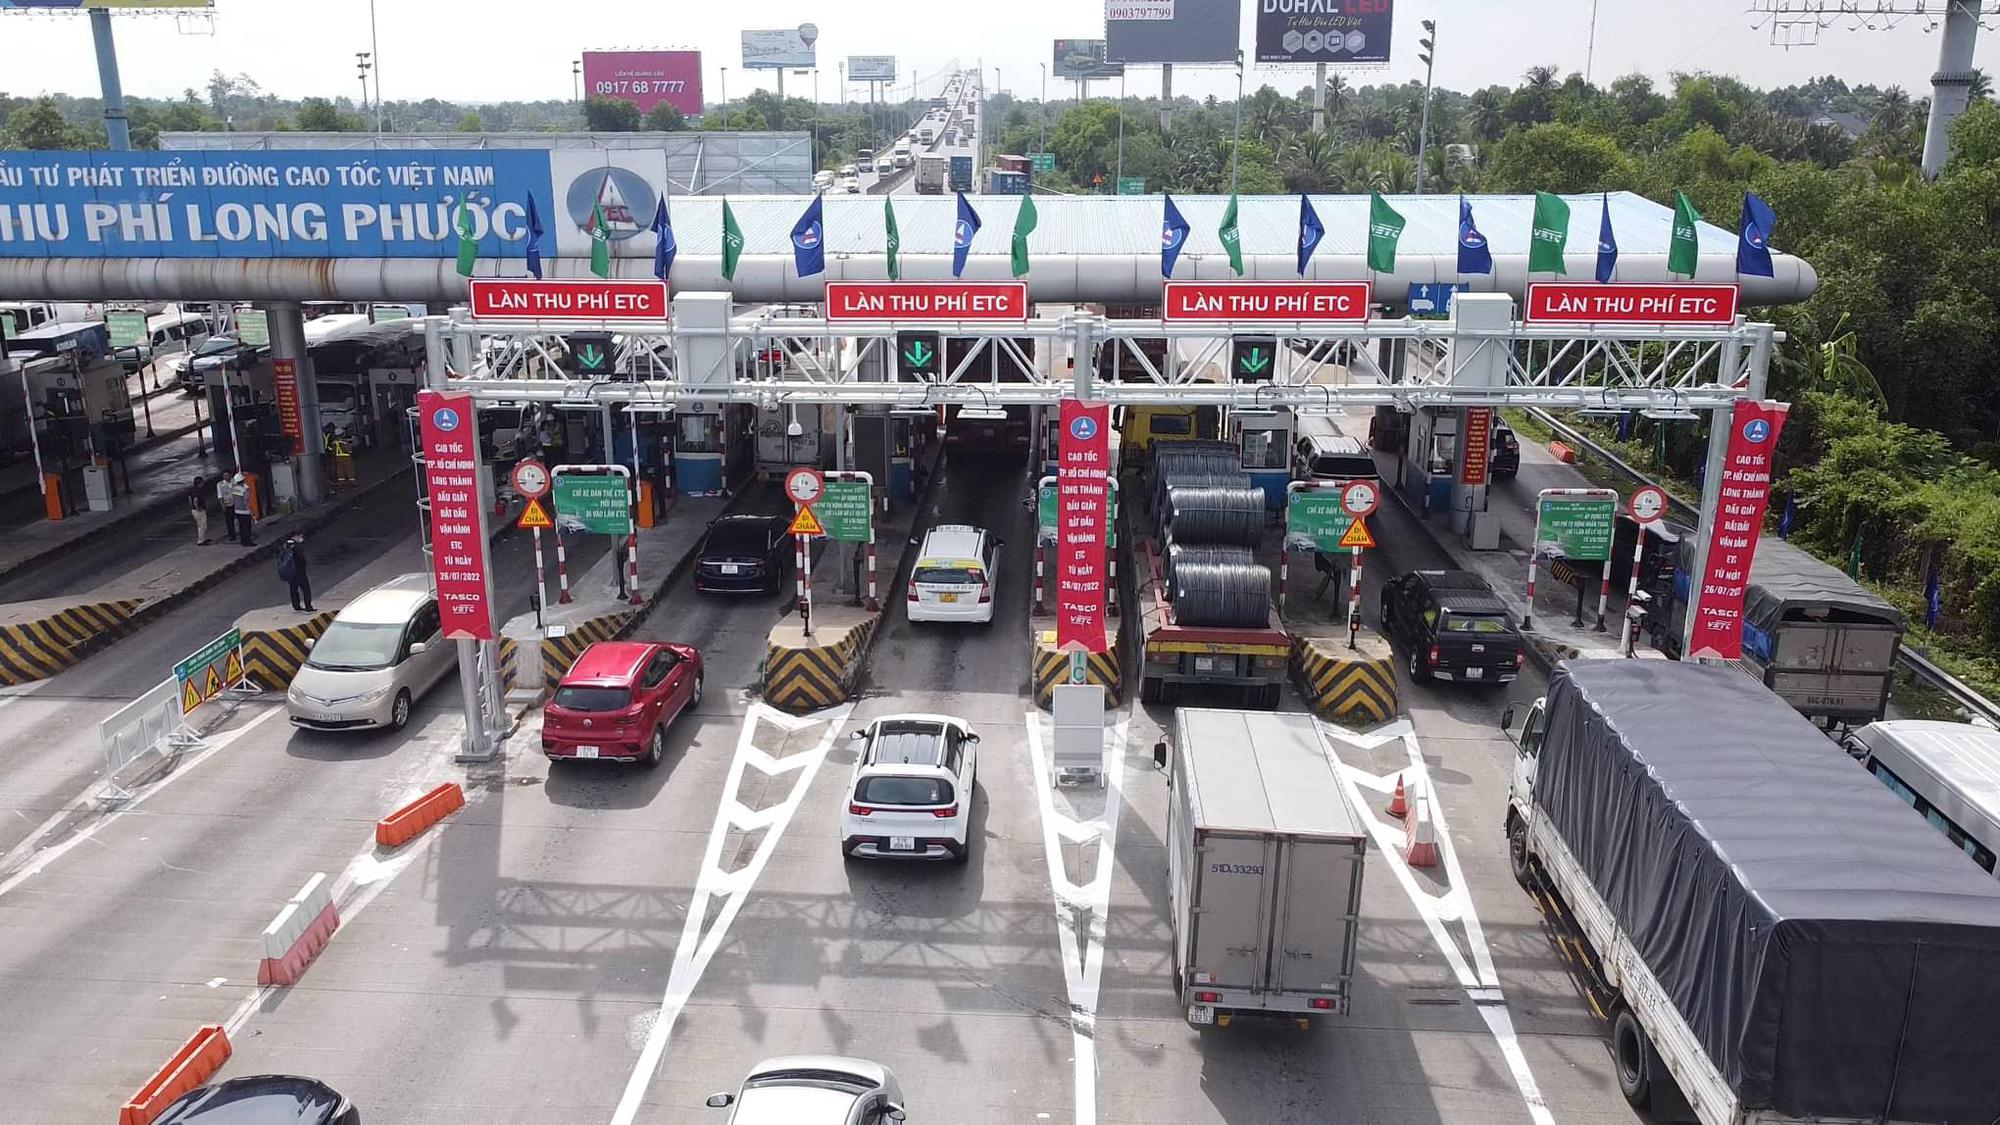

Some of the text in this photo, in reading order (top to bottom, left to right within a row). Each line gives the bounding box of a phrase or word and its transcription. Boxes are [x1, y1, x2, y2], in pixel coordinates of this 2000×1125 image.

[1109, 8, 1171, 18] 0903797799
[596, 81, 685, 94] 0917 68 7777
[29, 163, 59, 187] TƯ
[68, 161, 124, 187] PHÁT
[131, 157, 196, 187] TRIỂN
[202, 160, 279, 187] ĐƯỜNG
[285, 166, 330, 187] CAO
[336, 159, 381, 187] TỐC
[386, 162, 437, 191] VIỆT
[444, 165, 494, 187] NAM
[83, 192, 174, 241] PHÍ
[186, 202, 328, 241] LONG
[342, 189, 528, 241] PHƯỚC
[488, 289, 649, 310] LÀN THU PHÍ ETC
[844, 291, 1008, 311] LÀN THU PHÍ ETC
[1183, 290, 1350, 312] LÀN THU PHÍ ETC
[1545, 292, 1717, 314] LÀN THU PHÍ ETC
[449, 442, 463, 453] TỐC
[1068, 450, 1098, 461] CAO TỐC
[1736, 453, 1765, 465] CAO TỐC
[1062, 483, 1103, 495] LONG THÀNH
[1723, 487, 1764, 498] LONG THÀNH
[451, 541, 463, 550] ETC
[1075, 550, 1085, 560] ETC
[440, 572, 480, 581] 26/07/2022
[1062, 580, 1099, 591] 26/07/2022
[1063, 602, 1096, 612] TASCO
[1702, 607, 1738, 617] TASCO
